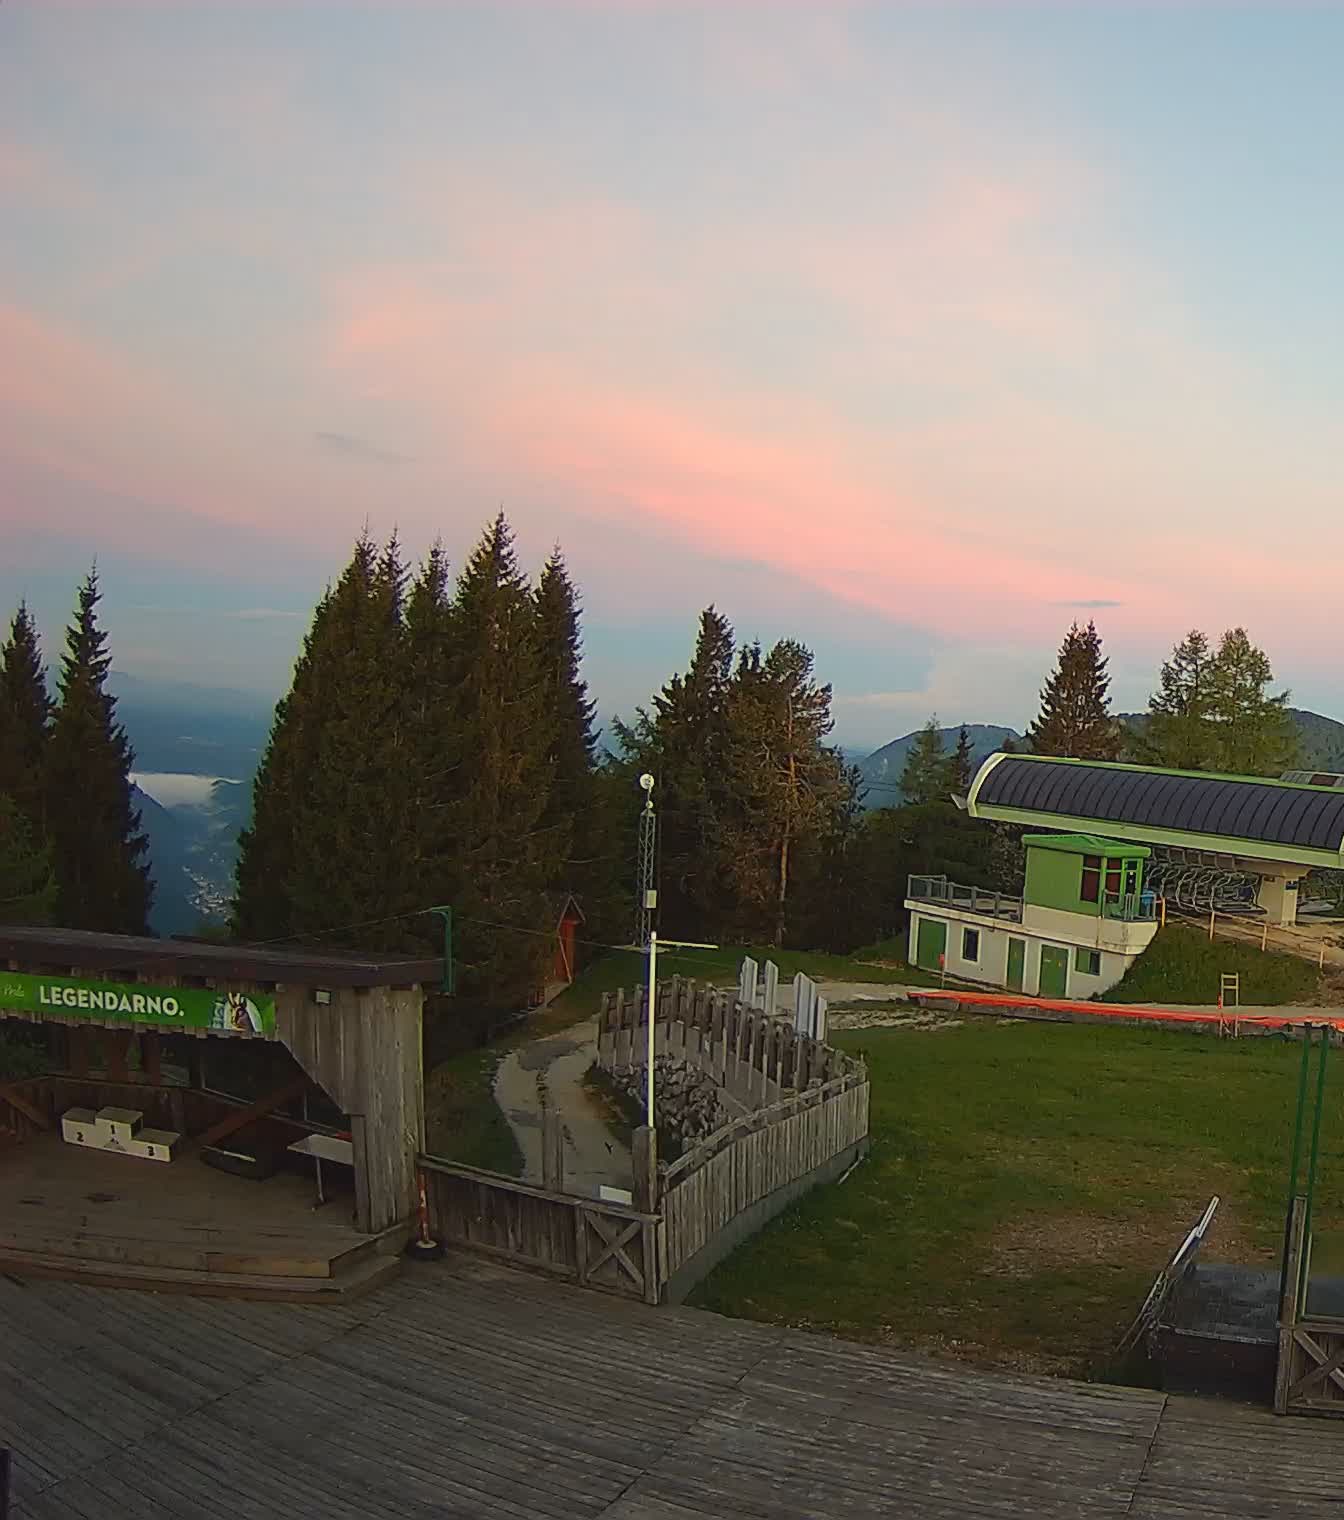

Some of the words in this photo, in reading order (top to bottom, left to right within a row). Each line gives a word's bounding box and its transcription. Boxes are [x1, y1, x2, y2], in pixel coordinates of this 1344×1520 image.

[39, 985, 185, 1017] LEGENDARNO.
[77, 1131, 85, 1143] 2
[147, 1145, 156, 1157] 3
